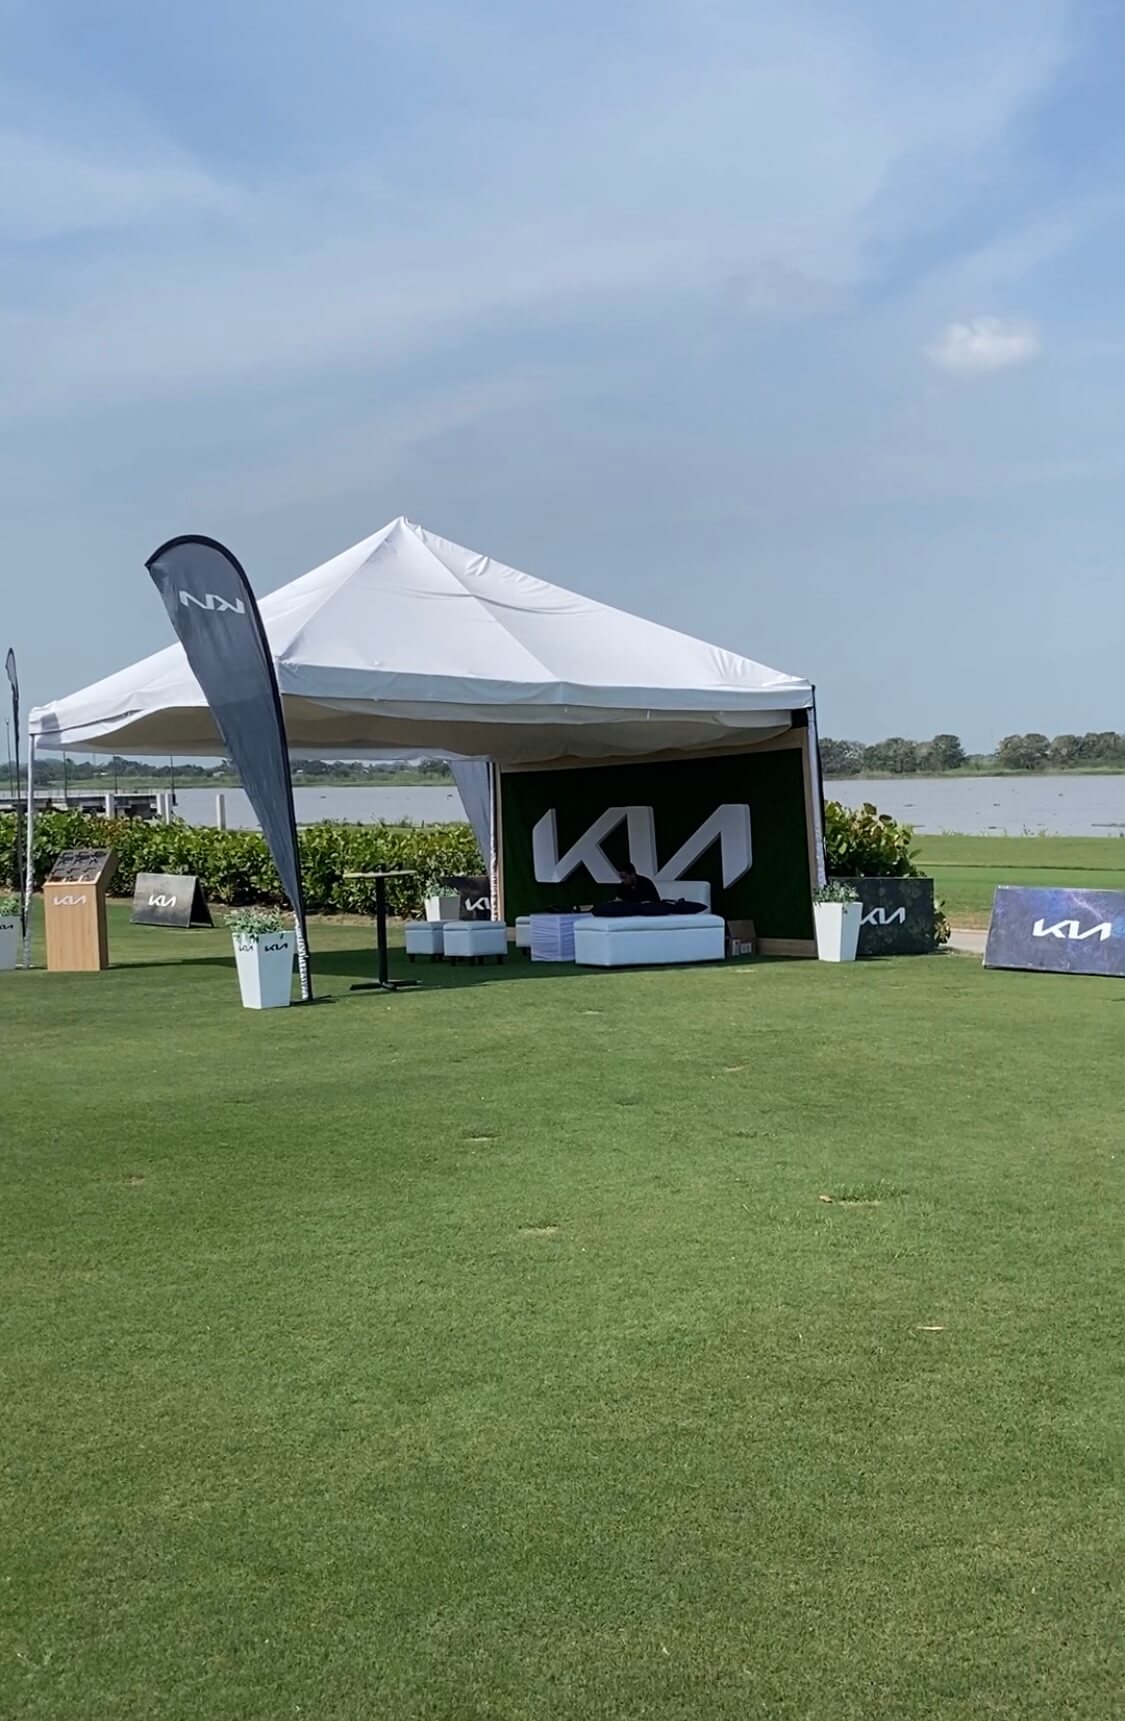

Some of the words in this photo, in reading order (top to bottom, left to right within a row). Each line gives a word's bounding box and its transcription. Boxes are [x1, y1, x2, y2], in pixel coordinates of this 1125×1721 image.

[532, 804, 752, 889] KIA
[53, 895, 86, 906] KIA
[148, 895, 176, 907] KIA
[465, 897, 490, 911] KI
[1032, 918, 1112, 941] KIA
[264, 942, 288, 952] KIA
